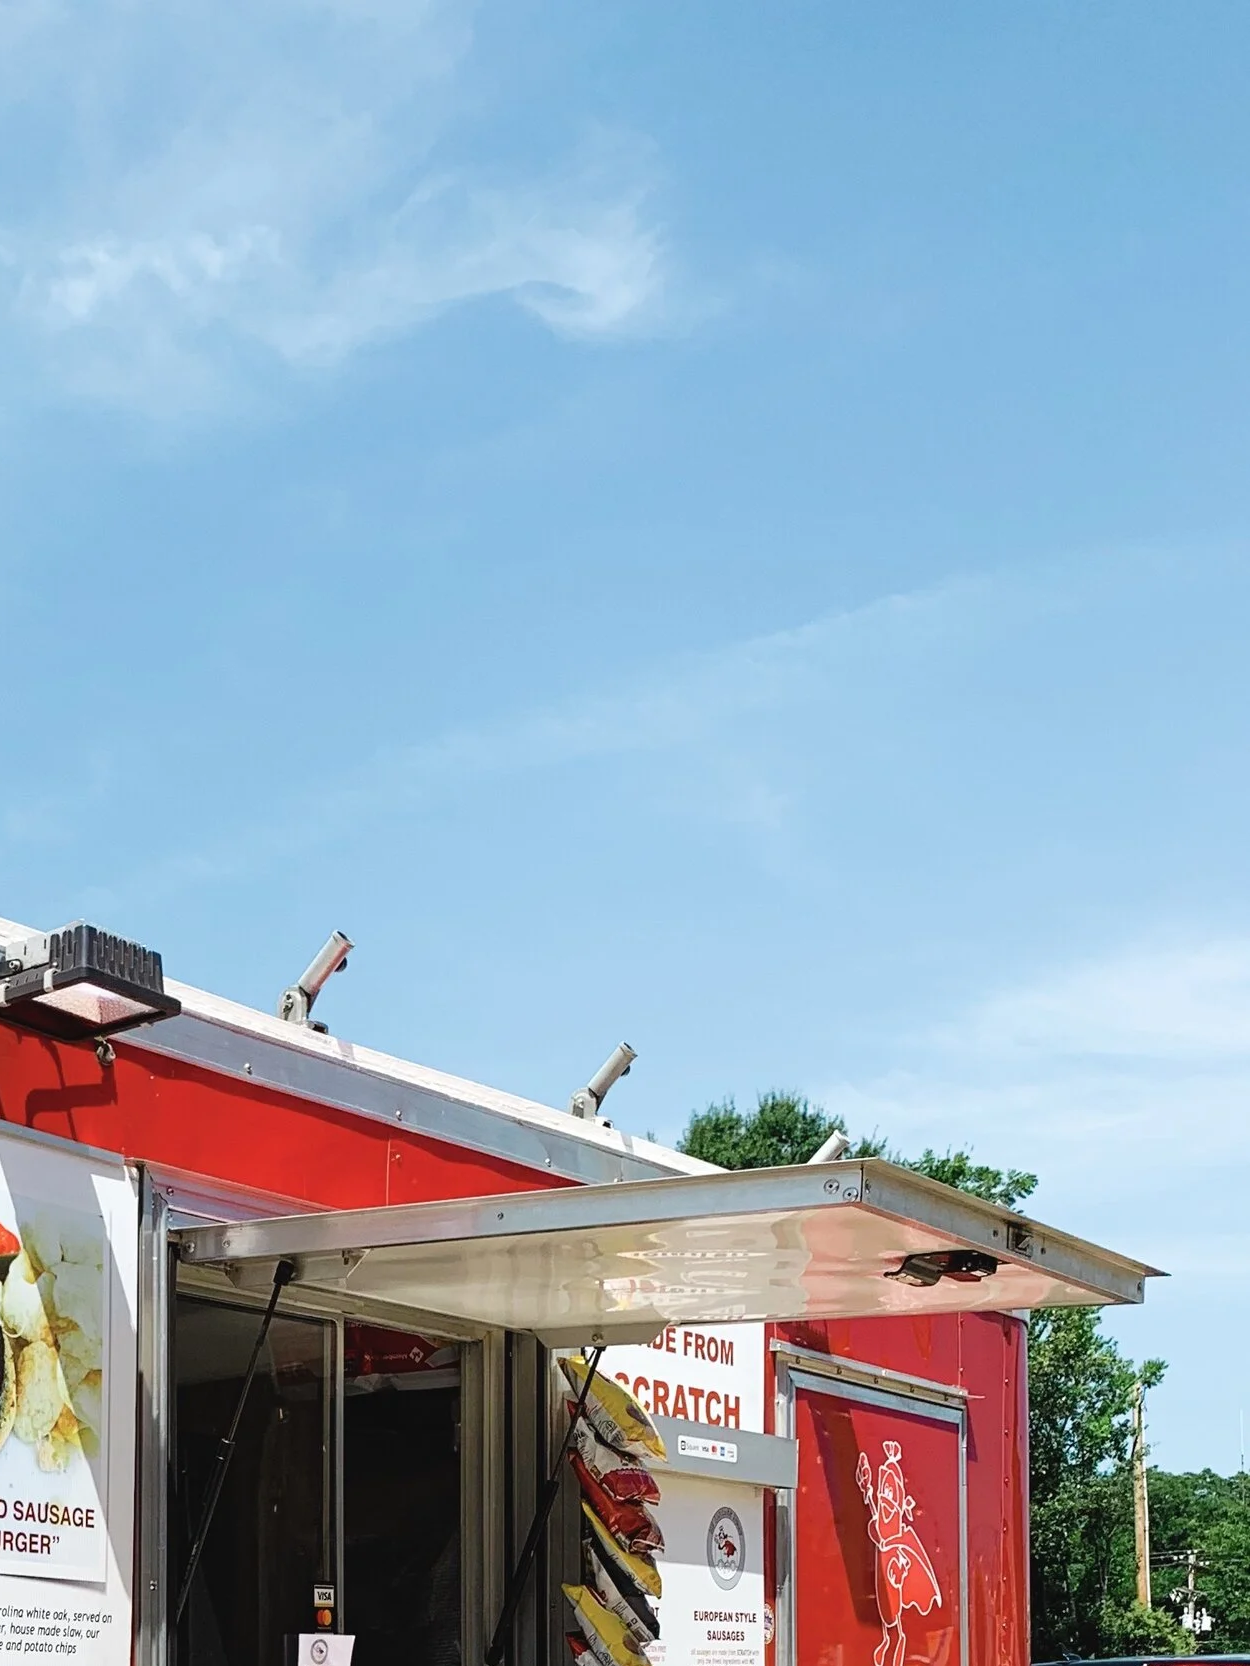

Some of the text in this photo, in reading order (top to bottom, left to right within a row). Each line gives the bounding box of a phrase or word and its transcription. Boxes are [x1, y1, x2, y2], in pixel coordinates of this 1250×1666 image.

[684, 1332, 734, 1366] FROM
[13, 1500, 95, 1528] SAUSAGE
[317, 1591, 332, 1601] VISA
[26, 1605, 50, 1620] white
[53, 1608, 71, 1623] oak,
[73, 1609, 100, 1623] served
[102, 1613, 112, 1624] on
[693, 1610, 757, 1623] EUROPEAN STYLE
[10, 1623, 35, 1636] house
[37, 1624, 61, 1637] made
[63, 1625, 84, 1639] slaw,
[86, 1628, 100, 1639] our
[707, 1630, 745, 1642] SAUSAGES
[5, 1639, 22, 1652] and
[24, 1640, 53, 1654] potato
[55, 1641, 77, 1655] chips
